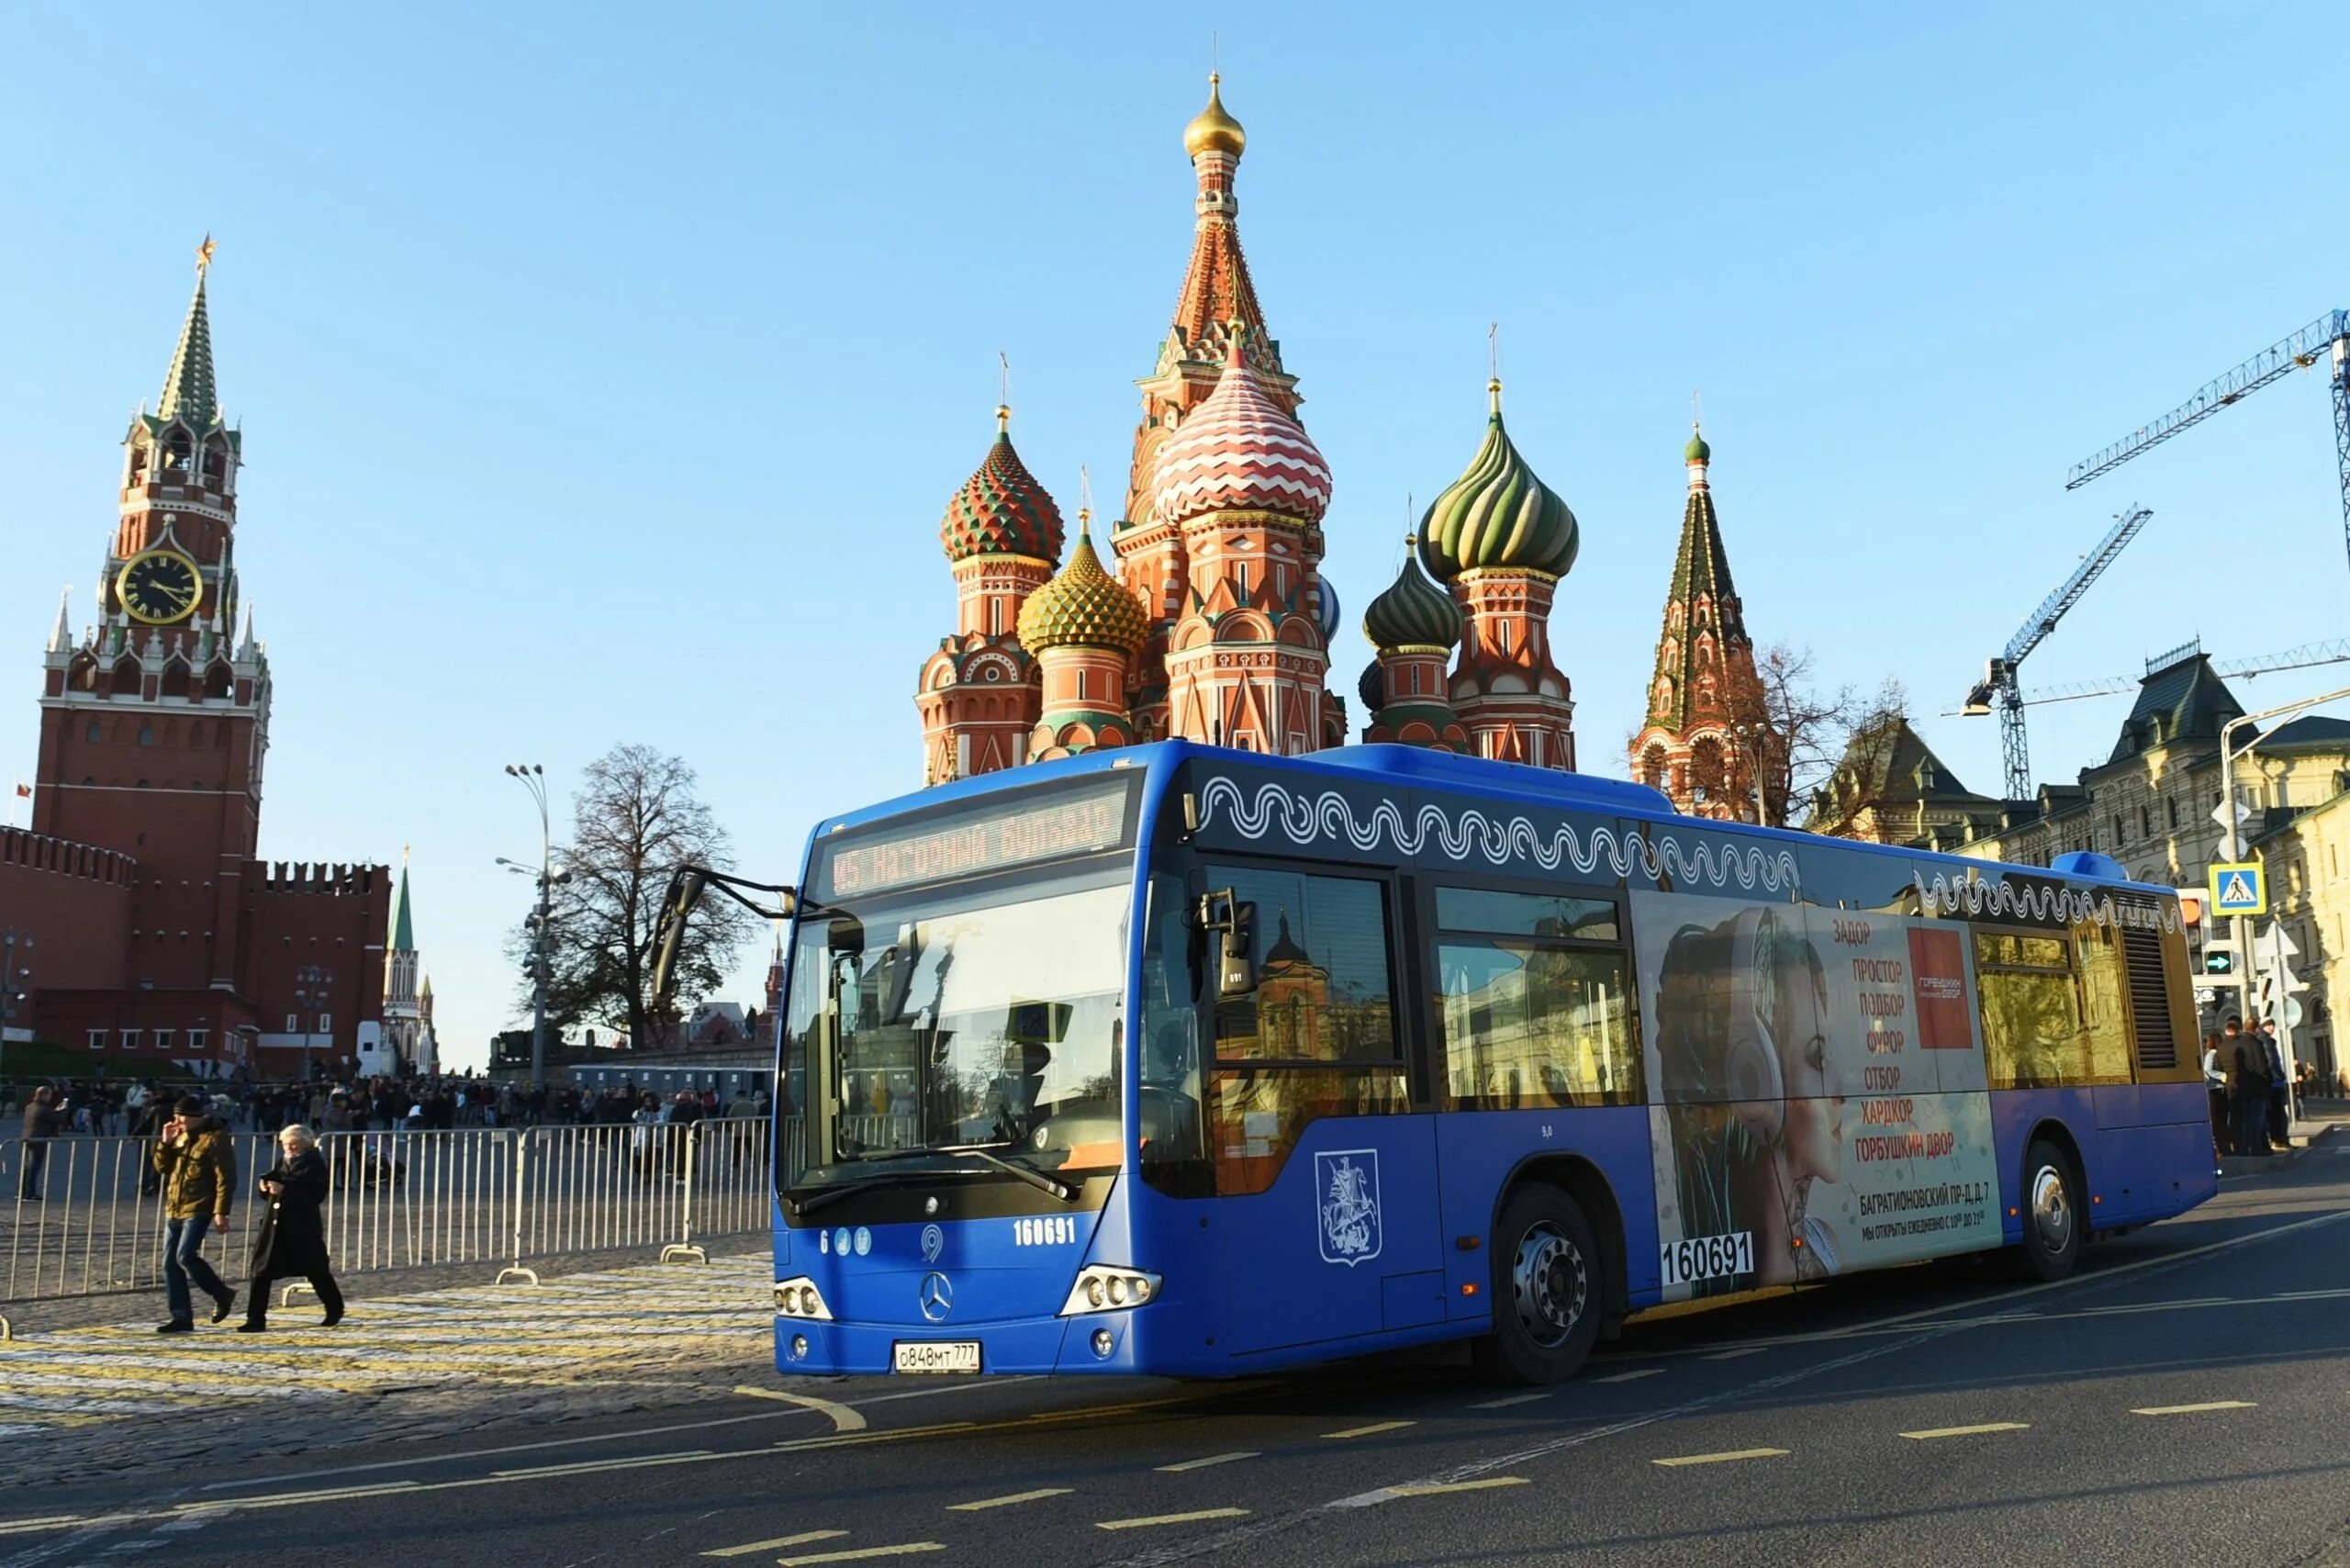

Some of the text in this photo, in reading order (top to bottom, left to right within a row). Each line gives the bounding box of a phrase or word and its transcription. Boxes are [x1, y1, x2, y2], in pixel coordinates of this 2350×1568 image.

[1832, 920, 1870, 947] ЗАДОР
[1852, 958, 1902, 983] ПРОСТОР
[1860, 992, 1905, 1019] ПОДБОР
[1867, 1031, 1904, 1055] ФУРОР
[1864, 1067, 1900, 1091] ОТБОР
[1861, 1099, 1913, 1126] ХАРДКОР
[1855, 1132, 1953, 1162] ГОРБУШКИН ДВОР
[1860, 1182, 1948, 1216] БАГРАТИОНОВСКИЙ
[1984, 1182, 1989, 1201] 7
[1013, 1216, 1075, 1246] 160691
[1862, 1226, 1874, 1241] МЫ
[1874, 1220, 1907, 1239] ОТКРЫТЫ
[1908, 1216, 1944, 1235] ЕЖЕДНЕВНО
[1945, 1215, 1950, 1229] С
[1964, 1214, 1973, 1227] ДО
[821, 1229, 829, 1254] 6
[1662, 1232, 1750, 1283] 160691
[954, 1344, 975, 1361] 777
